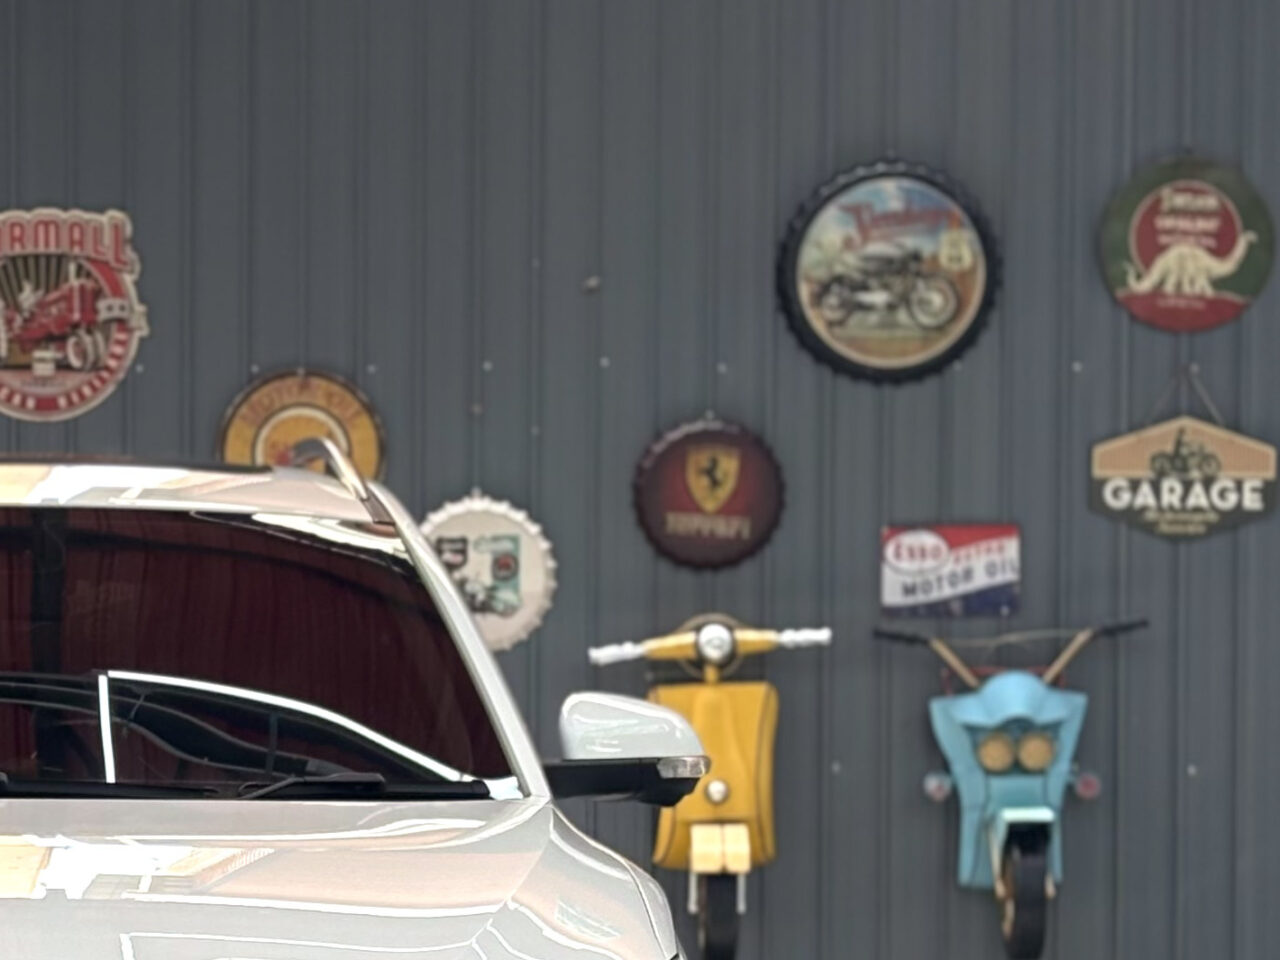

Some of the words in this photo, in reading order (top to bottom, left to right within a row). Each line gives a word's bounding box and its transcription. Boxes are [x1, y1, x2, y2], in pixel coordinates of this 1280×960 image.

[1102, 477, 1265, 511] GARAGE
[901, 566, 975, 598] MOTOR
[984, 558, 1019, 580] OIL
